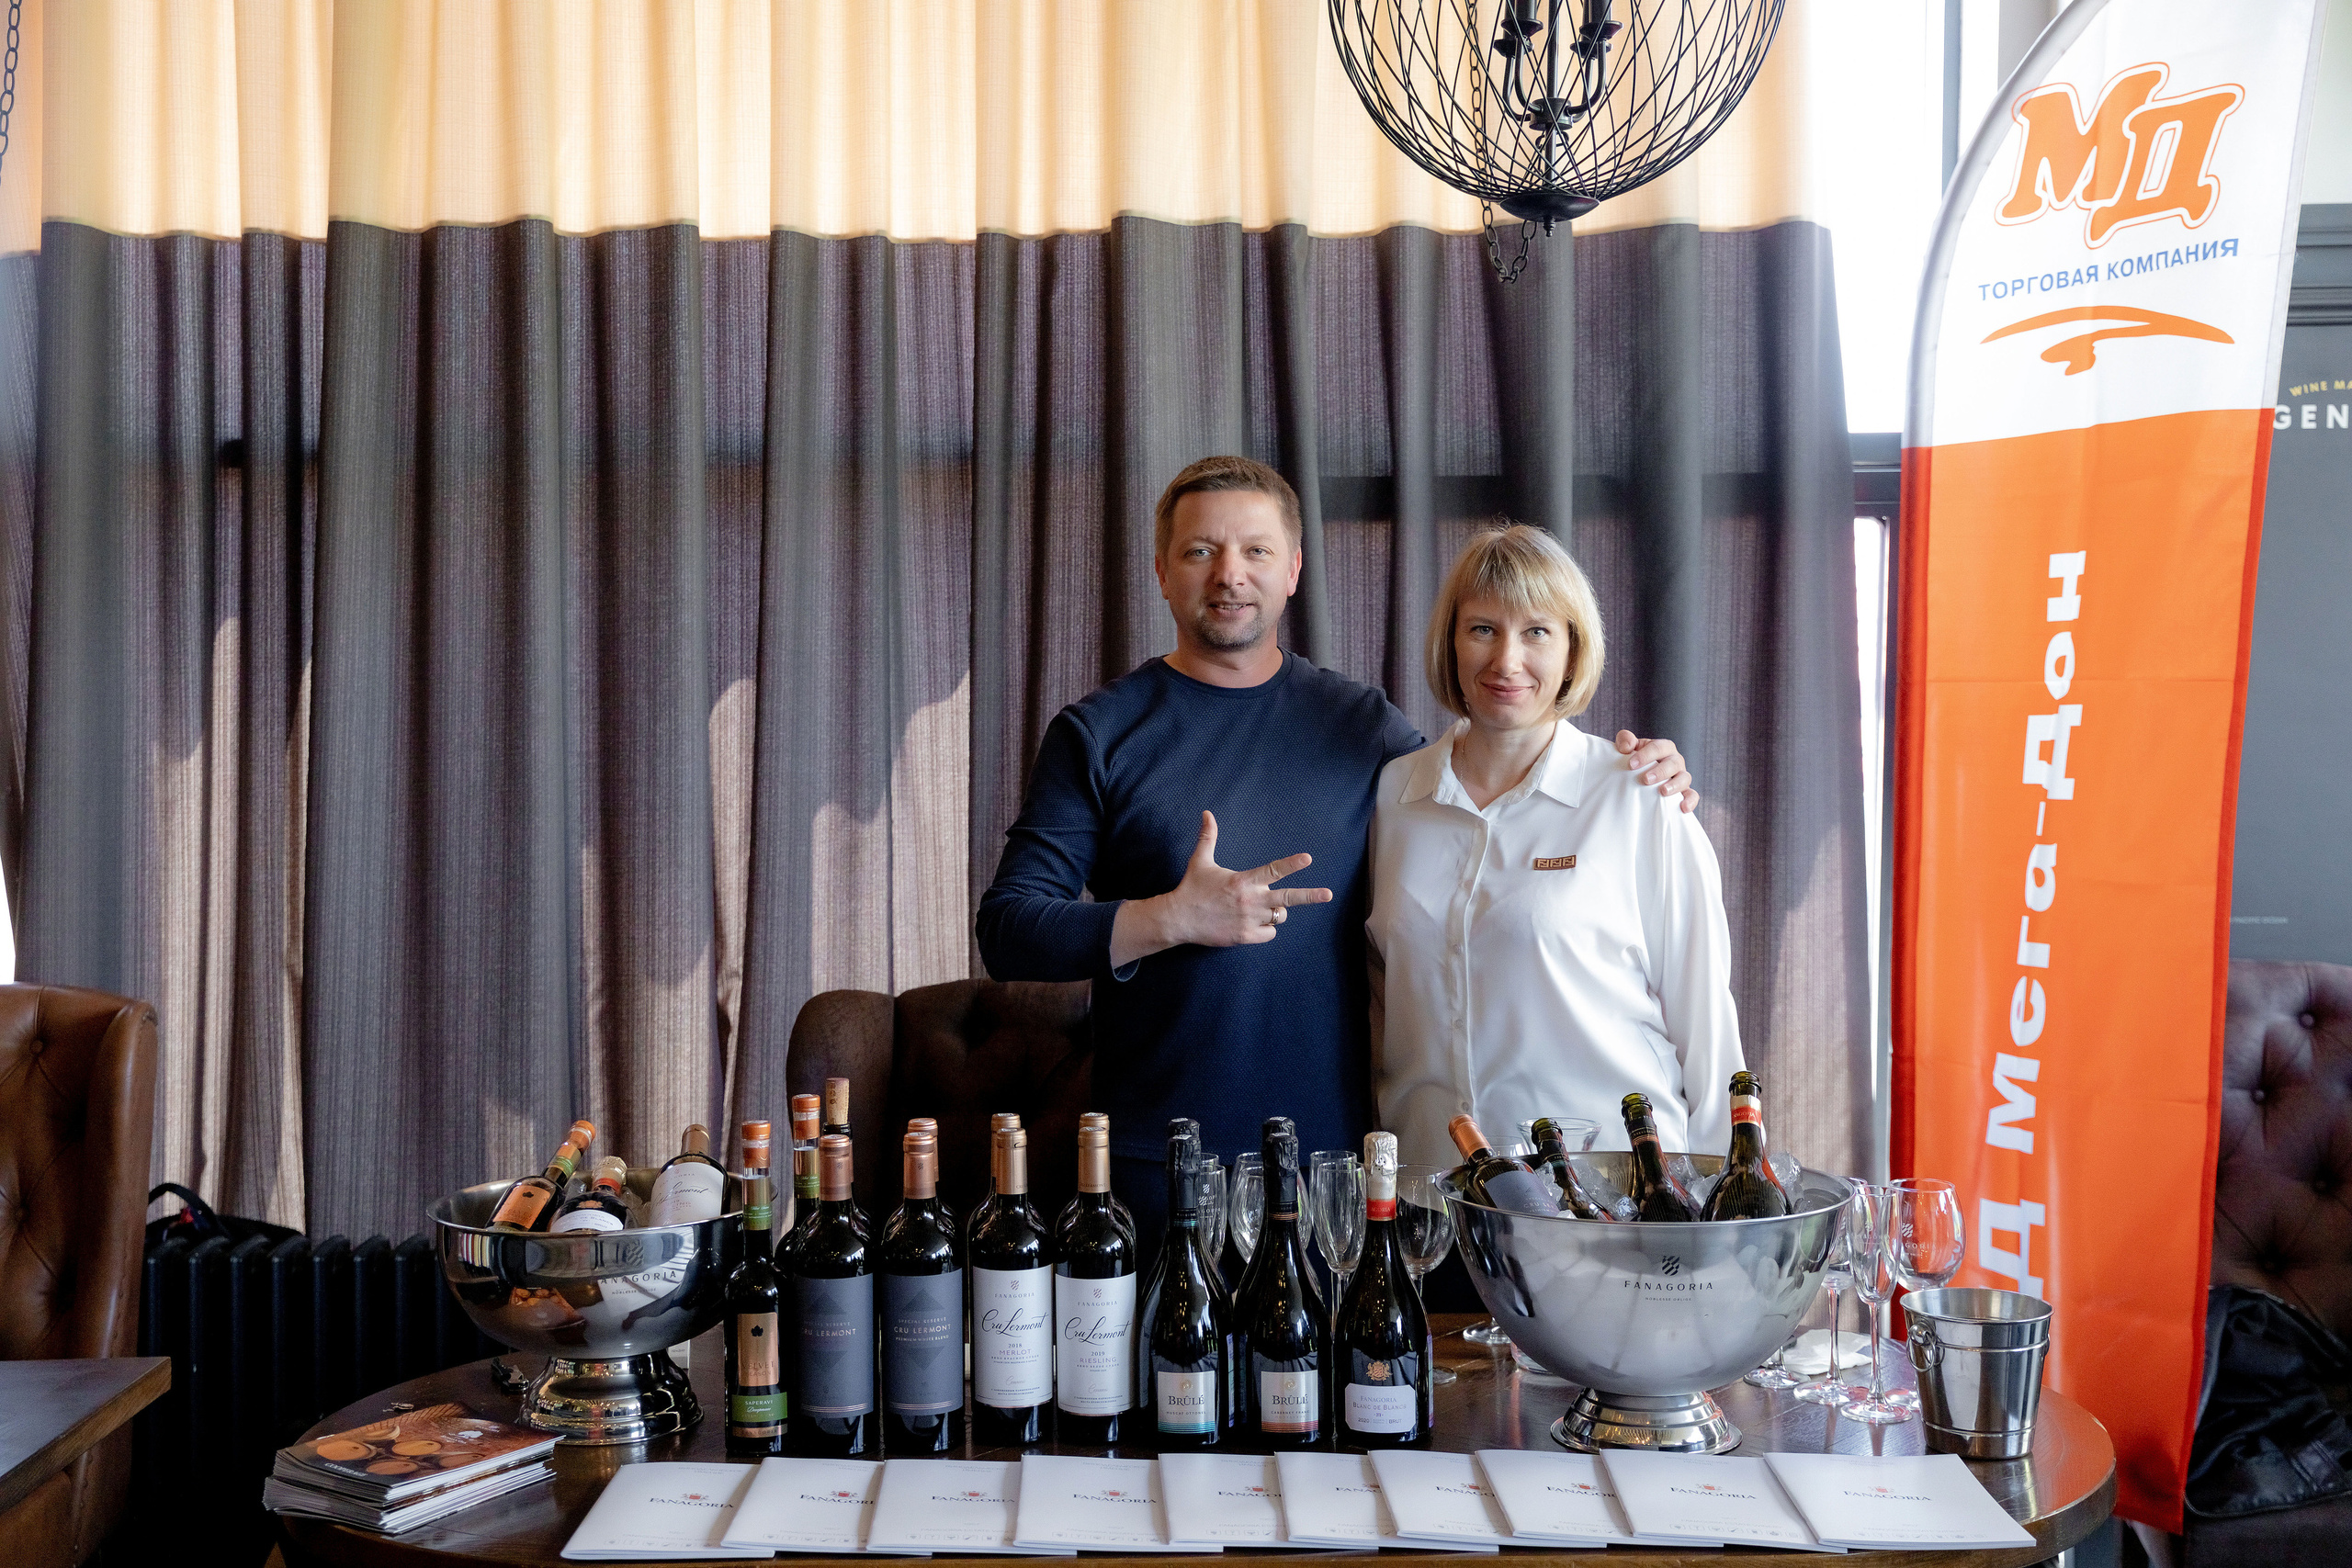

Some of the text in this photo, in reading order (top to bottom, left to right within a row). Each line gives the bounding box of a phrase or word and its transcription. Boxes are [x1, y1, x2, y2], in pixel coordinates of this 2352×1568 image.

[1978, 238, 2239, 302] ТОРГОВАЯ КОМПАНИЯ
[2289, 380, 2328, 397] WINE
[2273, 403, 2349, 430] GEN
[1979, 1199, 2045, 1300] Д
[1624, 1280, 1713, 1292] FANAGORIA
[981, 1307, 1049, 1338] Cru Lermont
[816, 1328, 856, 1337] LERMONT
[893, 1323, 952, 1335] CRU LERMONT
[1064, 1315, 1132, 1347] Cru Lermont
[1168, 1393, 1204, 1406] BRÛLÉ
[1272, 1393, 1309, 1406] BRÛLÉ
[1352, 1402, 1372, 1410] BLANC
[1217, 1490, 1282, 1498] FANAGO
[1435, 1485, 1496, 1497] FANAGO
[1546, 1485, 1618, 1498] FANAGOR
[1669, 1486, 1757, 1500] FANAGORIA
[1842, 1490, 1932, 1502] FANAGORIA
[650, 1496, 734, 1508] FANAGORIA
[800, 1494, 876, 1505] FANAGORI
[932, 1495, 1016, 1503] FANAGORIA
[1073, 1493, 1158, 1504] FANAGORIA
